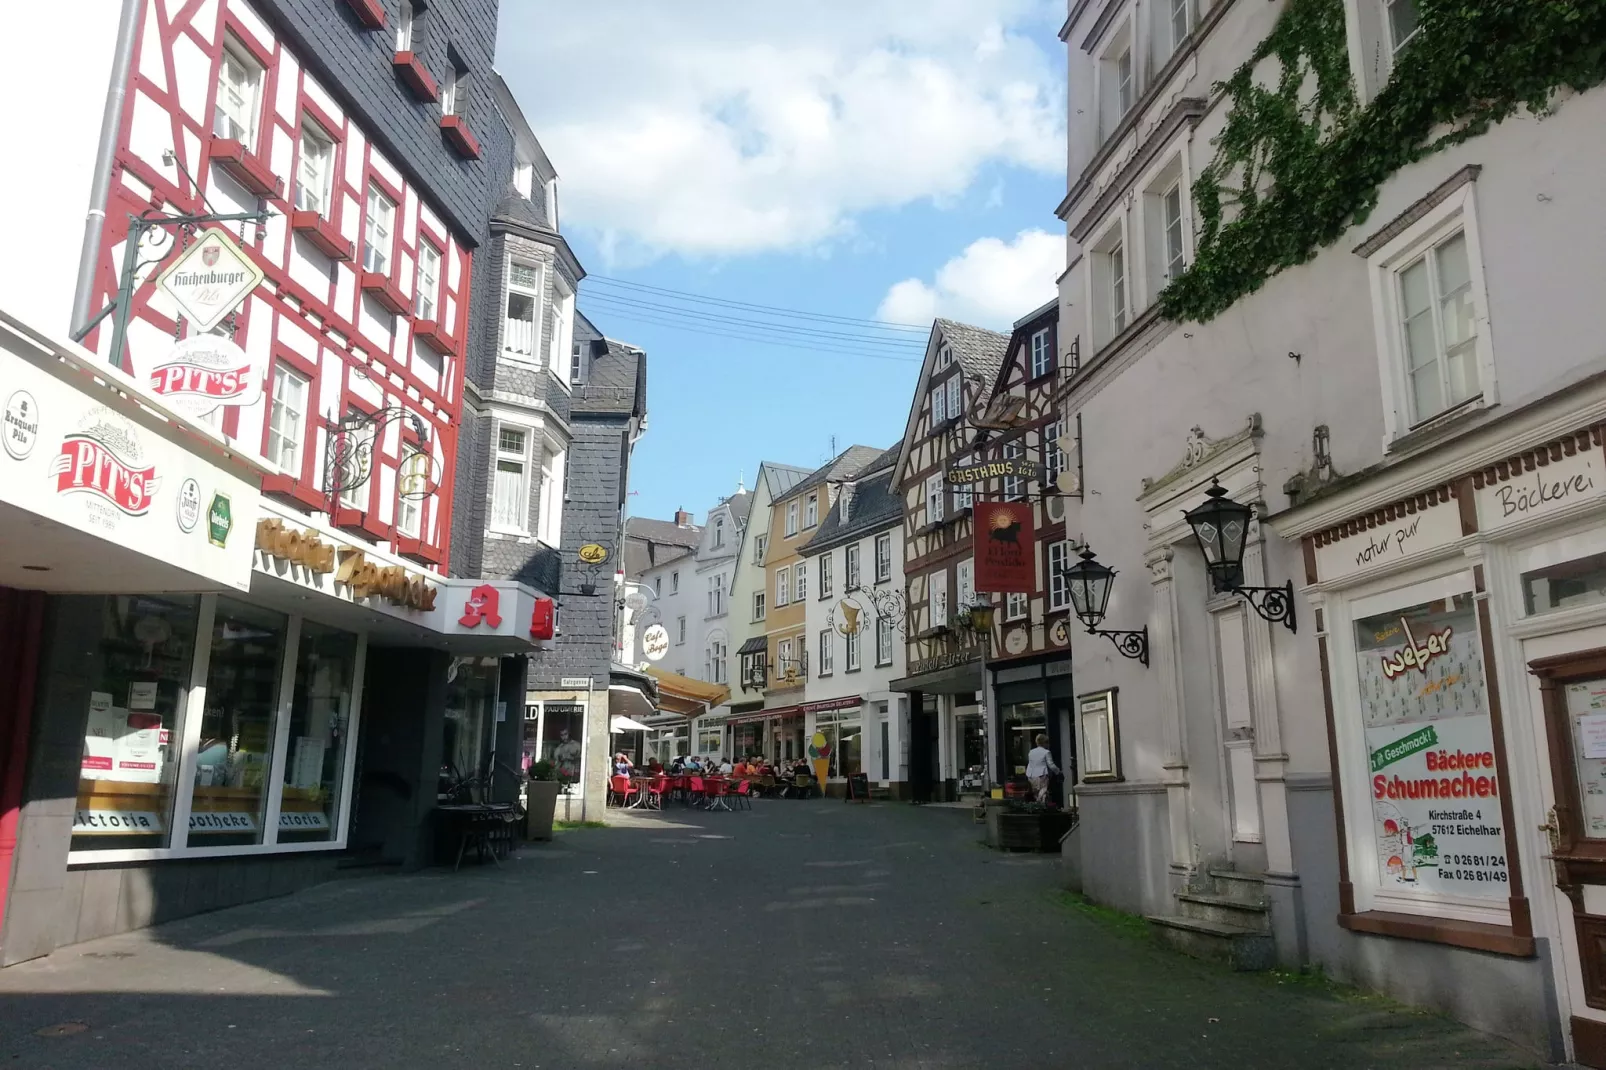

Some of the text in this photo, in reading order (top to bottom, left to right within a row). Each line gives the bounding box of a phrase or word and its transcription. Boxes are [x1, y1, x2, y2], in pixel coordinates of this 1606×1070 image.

[174, 270, 245, 287] Hachenburger
[5, 409, 38, 435] Erzquell
[12, 428, 27, 444] Pils
[948, 461, 1014, 484] GASTHAUS
[1495, 461, 1594, 517] Bäckerei
[1355, 515, 1420, 566] natur pur
[1382, 616, 1452, 679] weber
[1384, 730, 1431, 760] Geschmack!
[1428, 810, 1482, 821] Kirchstraße 4
[1432, 825, 1455, 835] 57612
[1438, 869, 1454, 880] Fax
